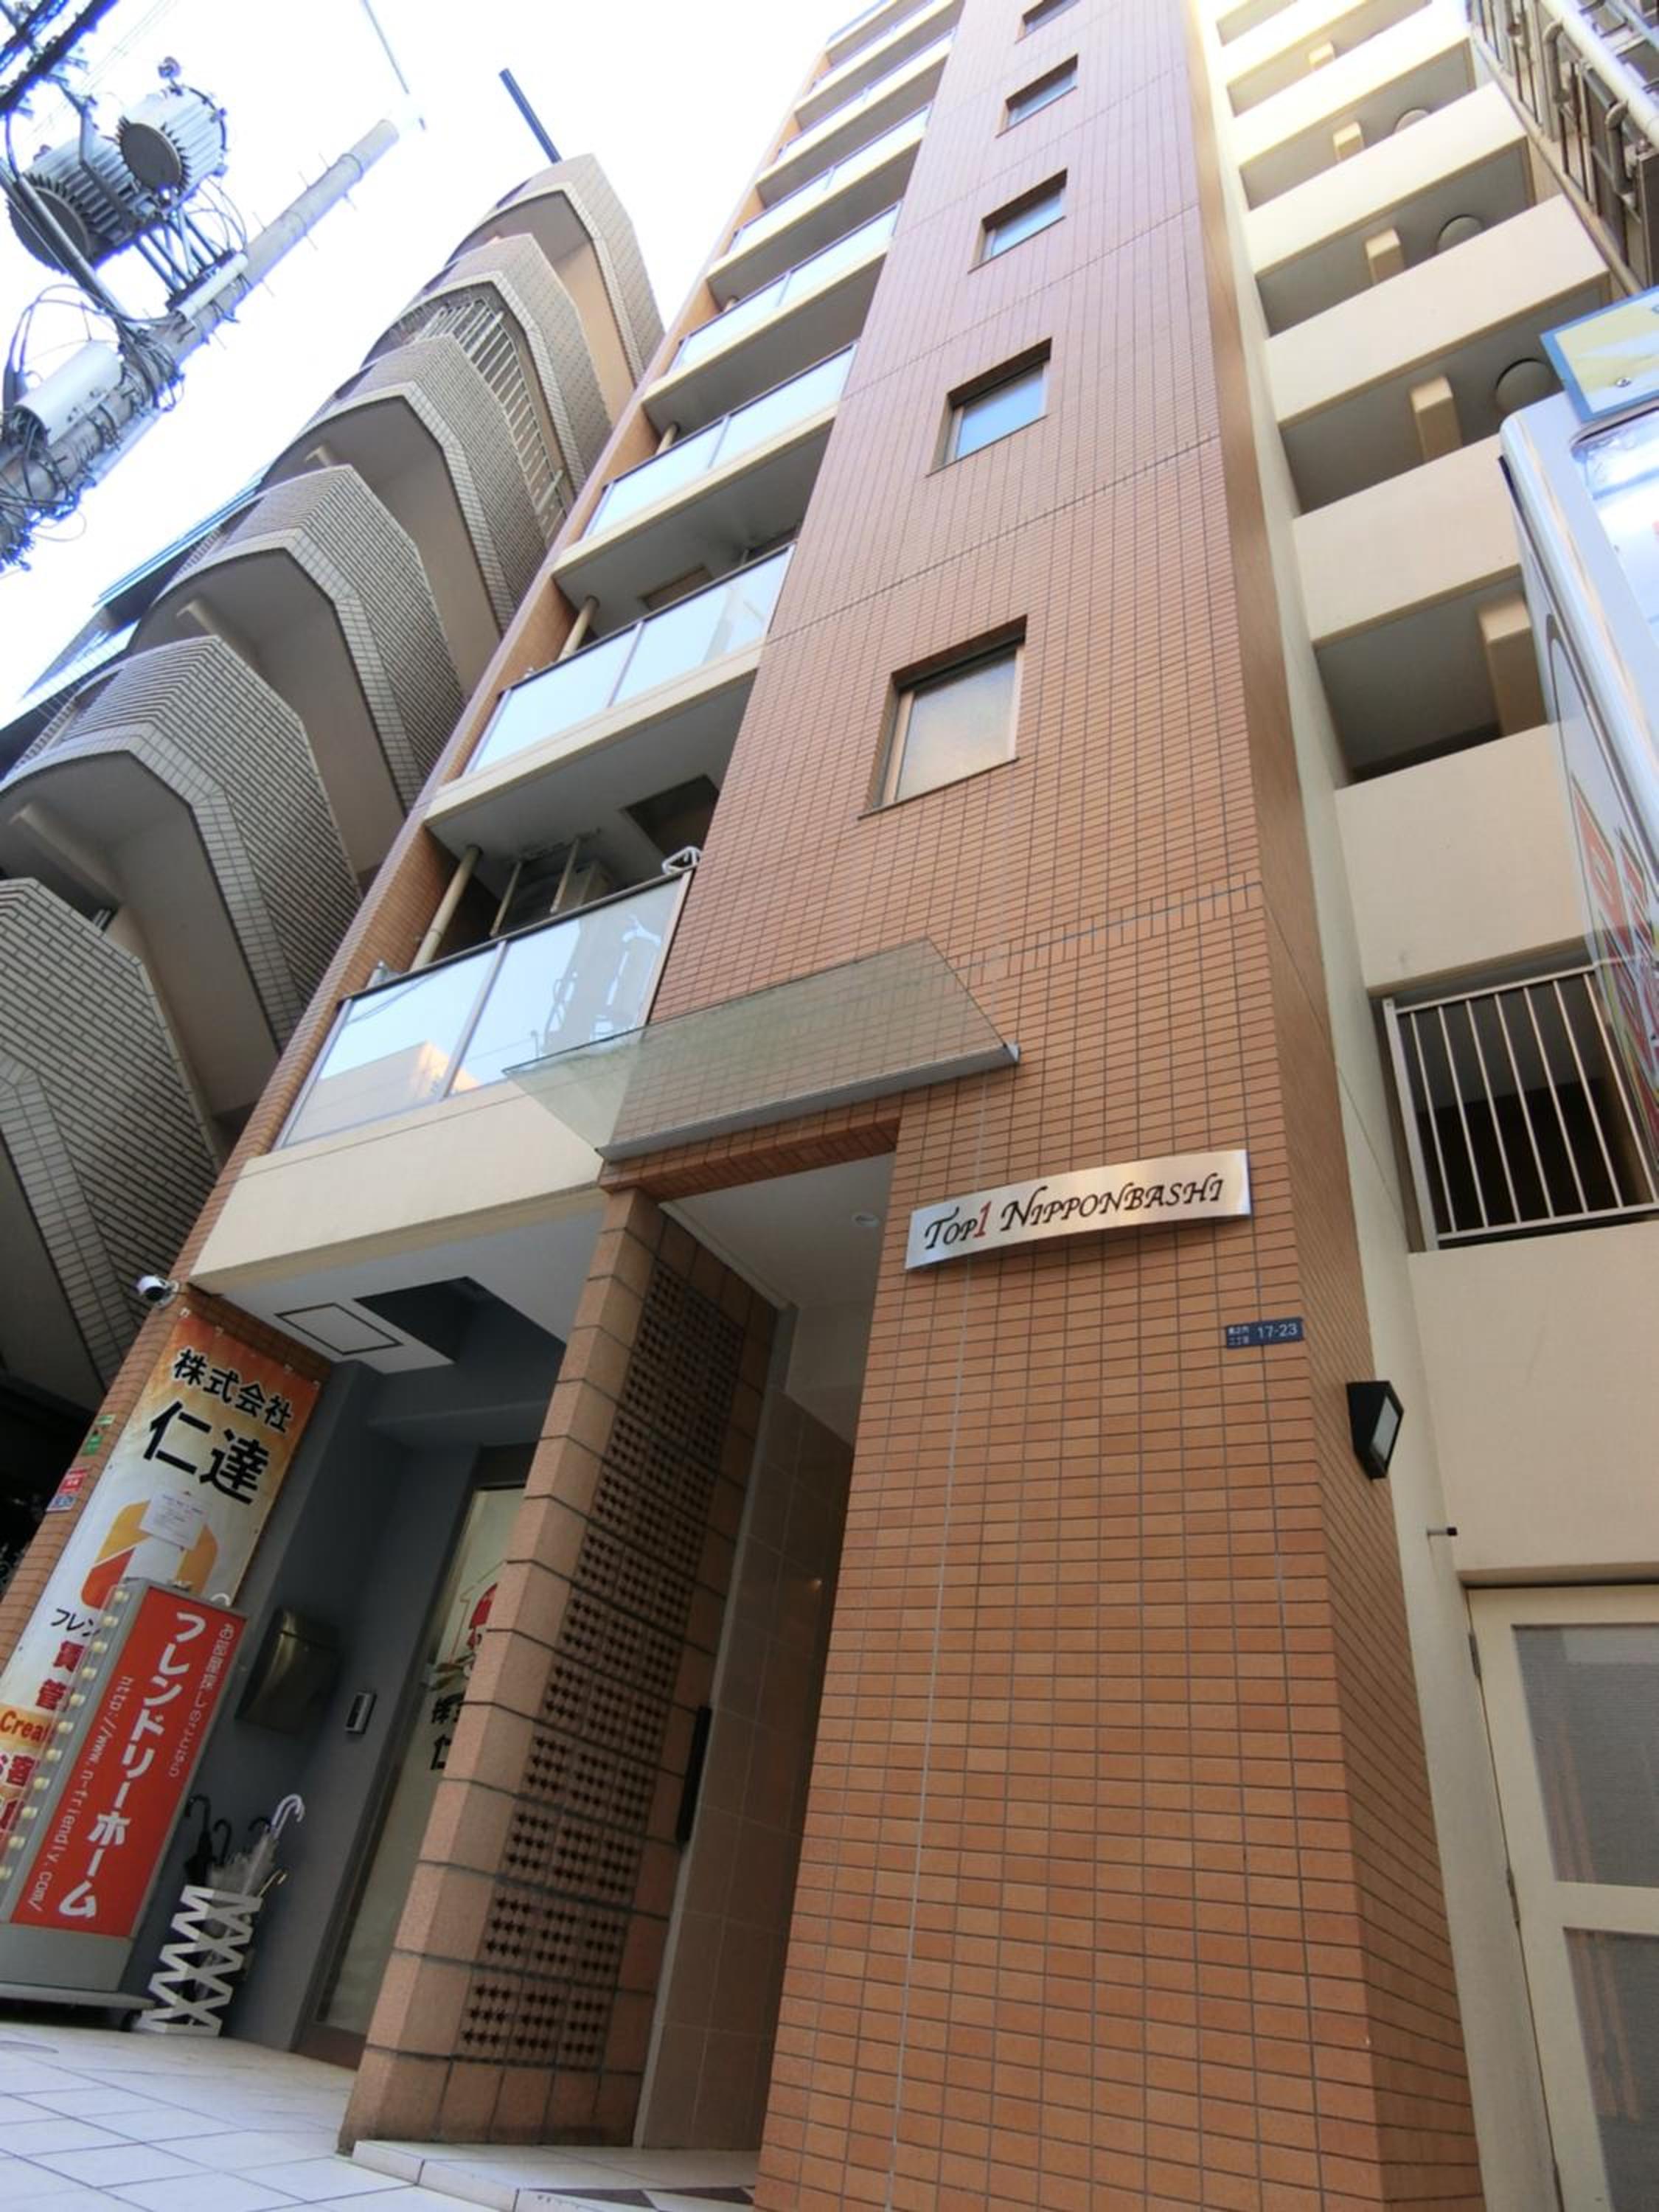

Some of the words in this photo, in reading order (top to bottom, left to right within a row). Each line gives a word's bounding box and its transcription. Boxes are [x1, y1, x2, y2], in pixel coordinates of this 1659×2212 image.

[1257, 1322, 1298, 1340] 17-23
[173, 1349, 292, 1434] 株式会社
[143, 1400, 270, 1506] 仁達
[28, 1675, 135, 1913] http://www.n-friendly.com/
[58, 1611, 206, 1919] フレンドリーホーム
